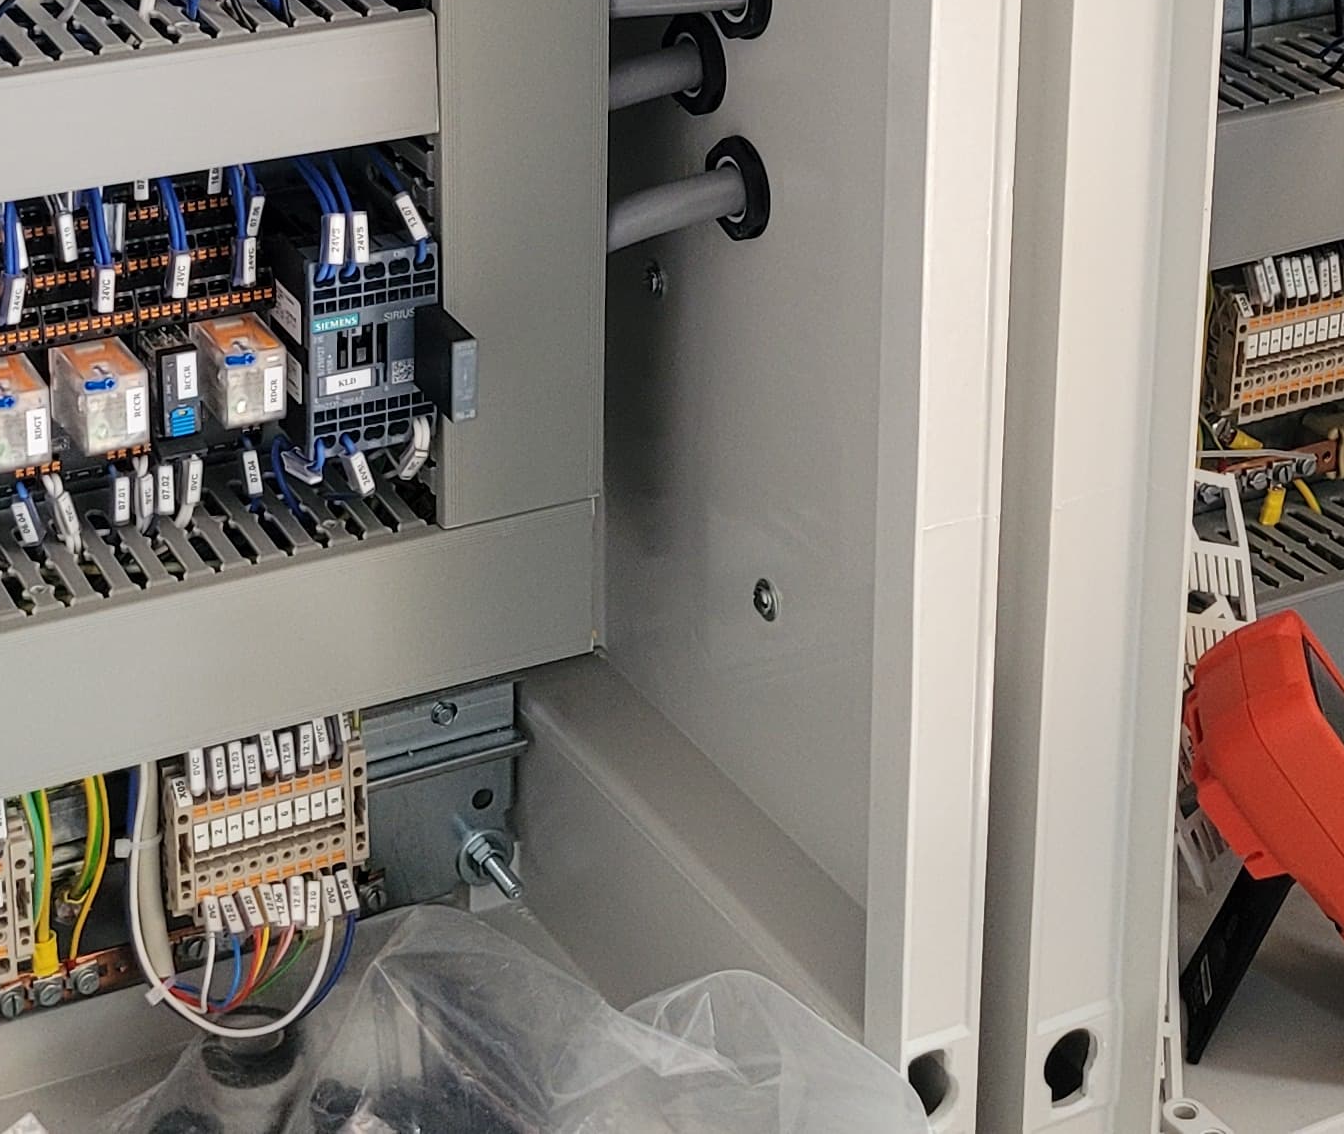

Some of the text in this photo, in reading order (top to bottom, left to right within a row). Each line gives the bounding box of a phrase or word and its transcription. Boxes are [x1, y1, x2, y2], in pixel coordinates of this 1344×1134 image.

[402, 205, 416, 227] 13.07
[384, 308, 415, 321] SIRIUS
[315, 316, 358, 332] SIEMENS
[184, 365, 193, 390] RCGR
[250, 460, 259, 483] 07.04
[17, 513, 31, 534] 06.04
[316, 725, 325, 742] 0VC
[175, 781, 188, 799] X05
[326, 887, 336, 904] 0VC
